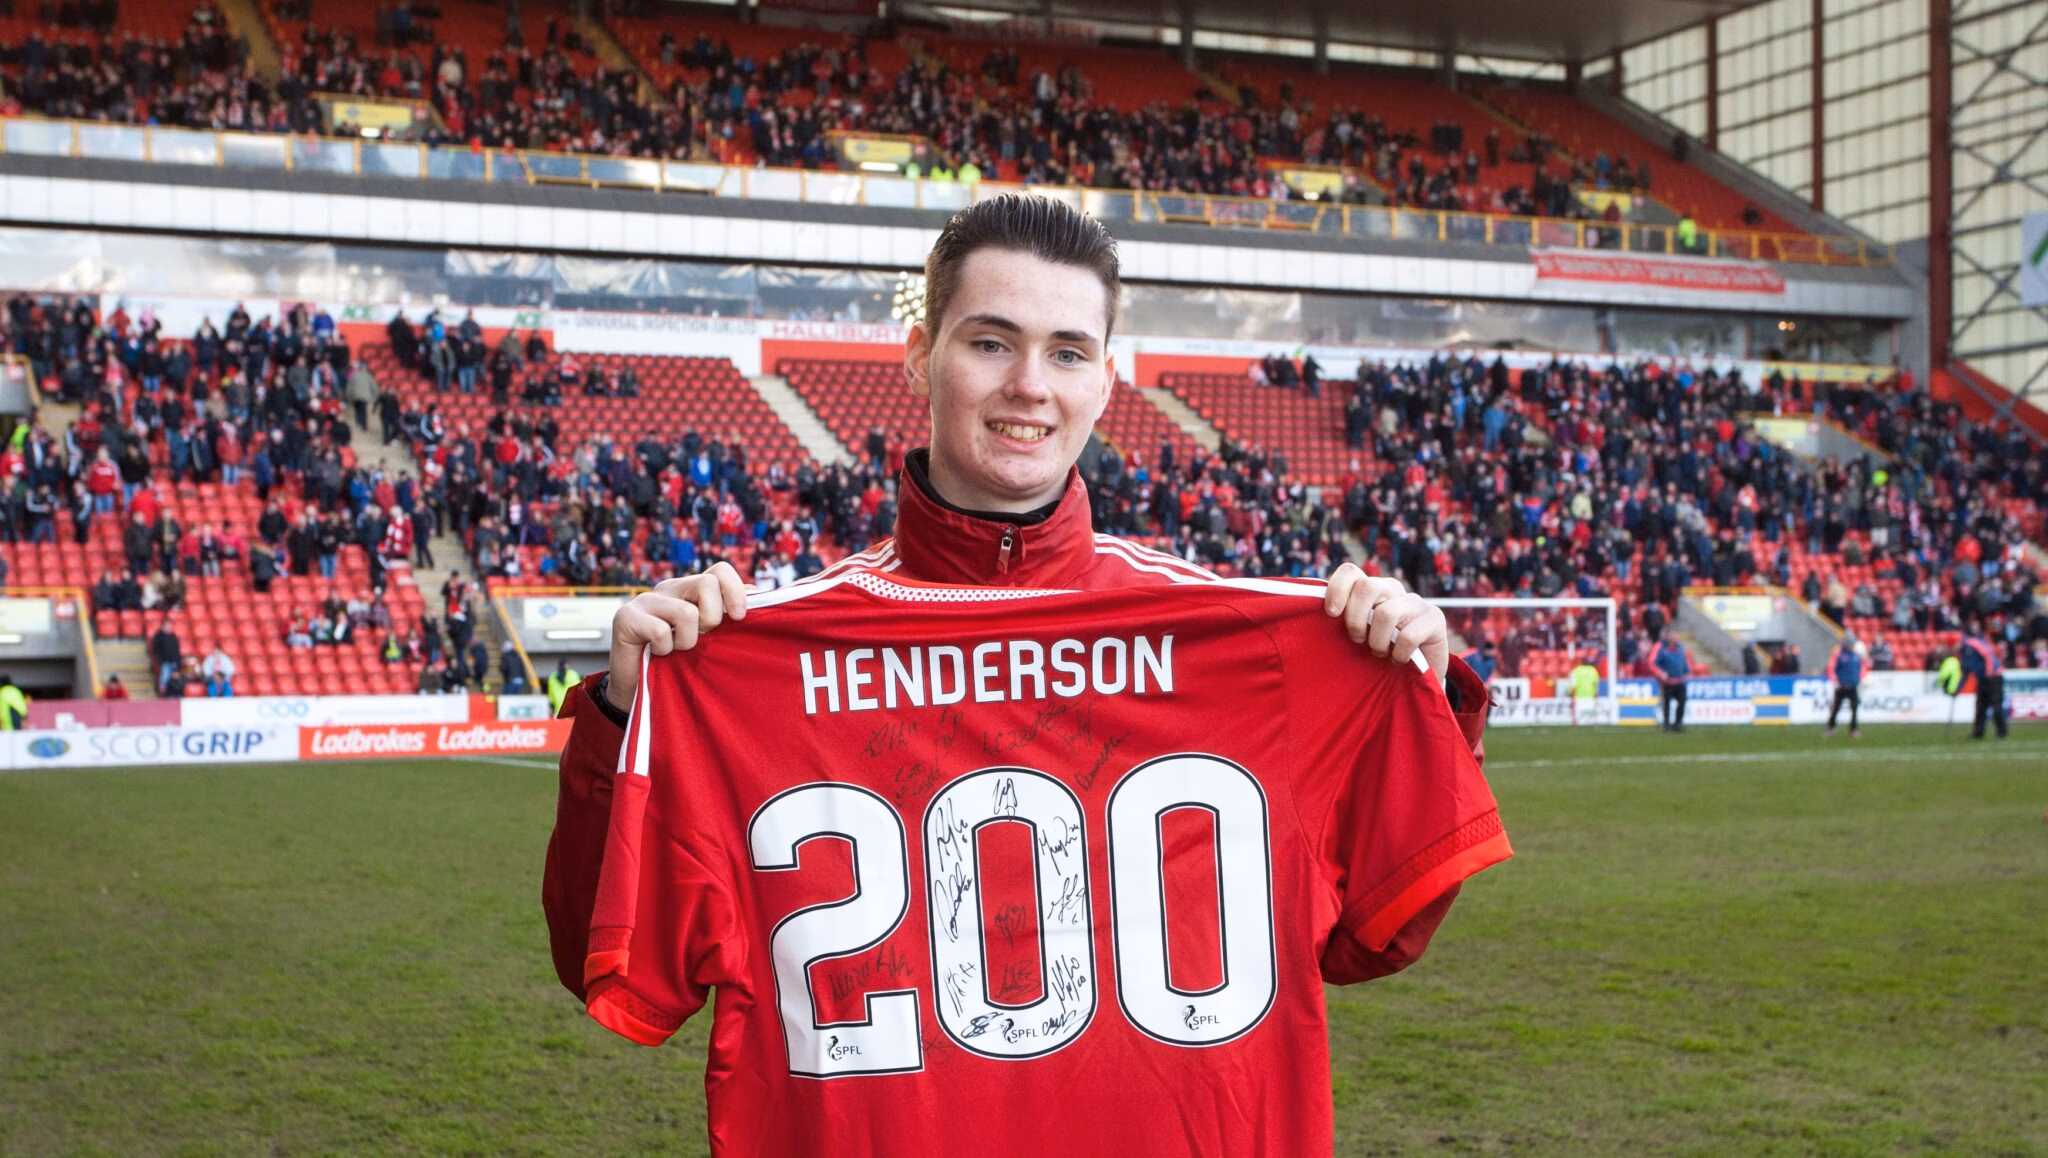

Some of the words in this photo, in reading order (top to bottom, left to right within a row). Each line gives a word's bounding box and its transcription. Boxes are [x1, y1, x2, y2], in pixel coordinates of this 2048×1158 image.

[773, 321, 907, 341] HALLIBURT
[800, 635, 1174, 716] HENDERSON
[89, 730, 263, 761] SCOTGRIP
[311, 728, 427, 755] Ladbrokes
[437, 725, 548, 750] Ladbrokes
[748, 752, 1277, 1080] 200
[1192, 1014, 1221, 1026] SPFL
[1010, 1027, 1039, 1039] SPFL
[834, 1045, 862, 1056] SPFL
